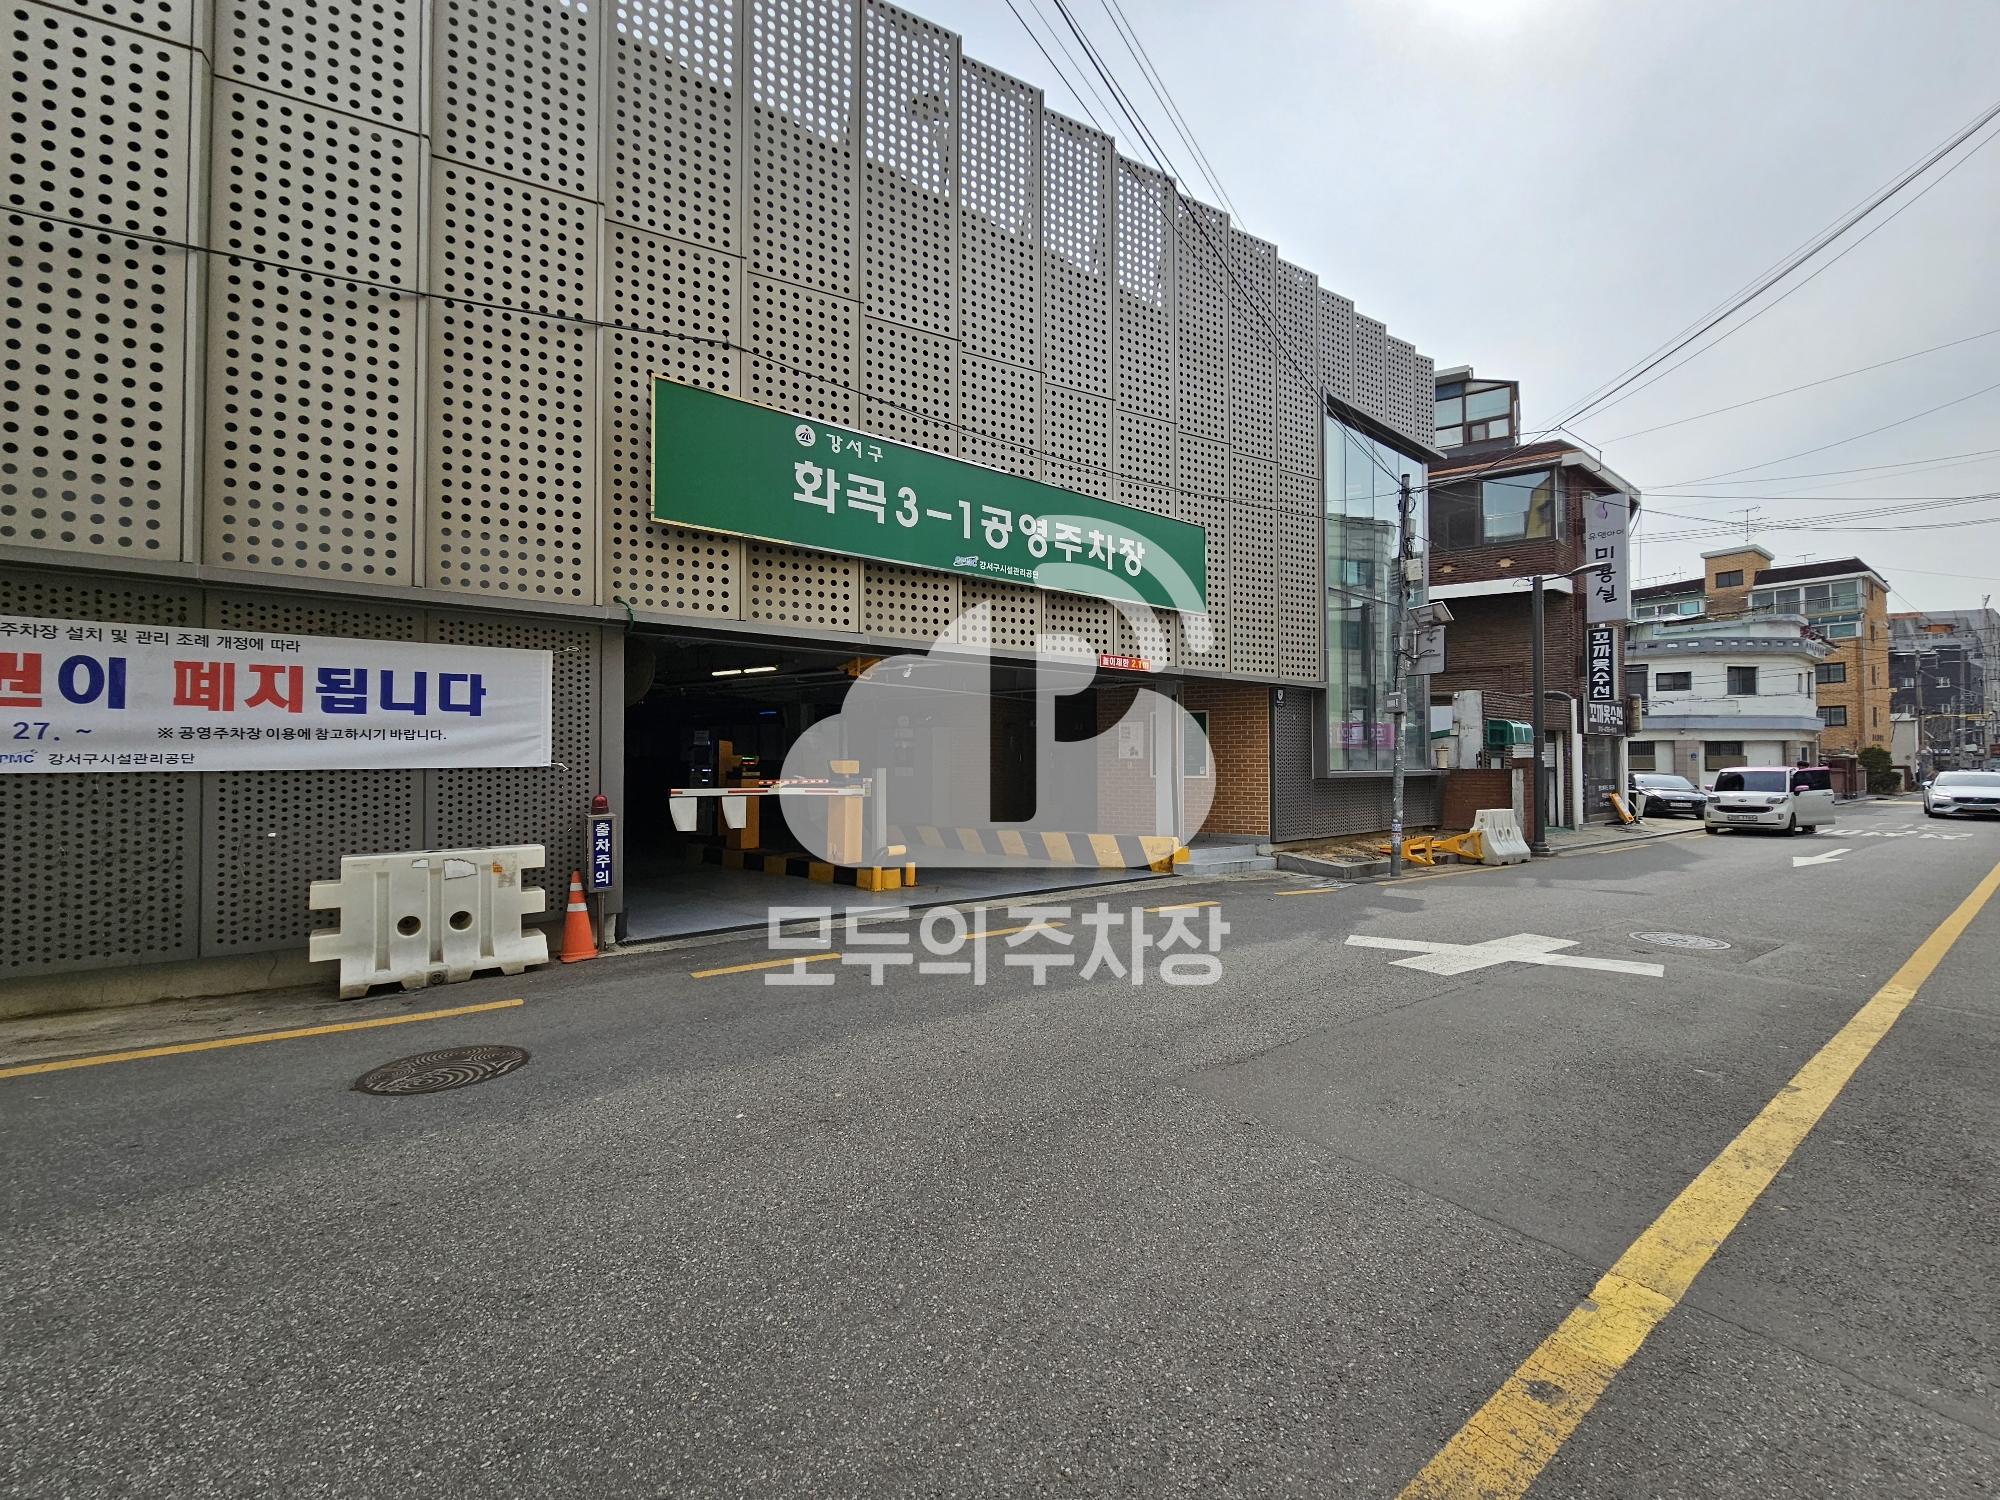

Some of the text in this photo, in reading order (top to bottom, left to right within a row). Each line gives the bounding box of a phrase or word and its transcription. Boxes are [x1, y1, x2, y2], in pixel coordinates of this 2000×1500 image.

[825, 433, 884, 463] 강서구
[979, 560, 1039, 580] 강서구시설관리공단
[1595, 545, 1618, 604] 미용실
[65, 625, 103, 643] 설치
[111, 629, 128, 643] 및
[136, 631, 169, 646] 관리
[176, 633, 210, 648] 조례
[217, 635, 264, 651] 개정에
[271, 639, 301, 653] 따라
[173, 660, 487, 717] 폐지됩니다
[12, 721, 60, 742] 27.
[178, 726, 262, 741] 공영주차장
[266, 727, 311, 741] 이용에
[315, 728, 386, 742] 참고하시기
[390, 729, 447, 741] 바랍니다.
[48, 752, 195, 766] 강서구시설관리공단
[595, 822, 611, 885] 출차주의
